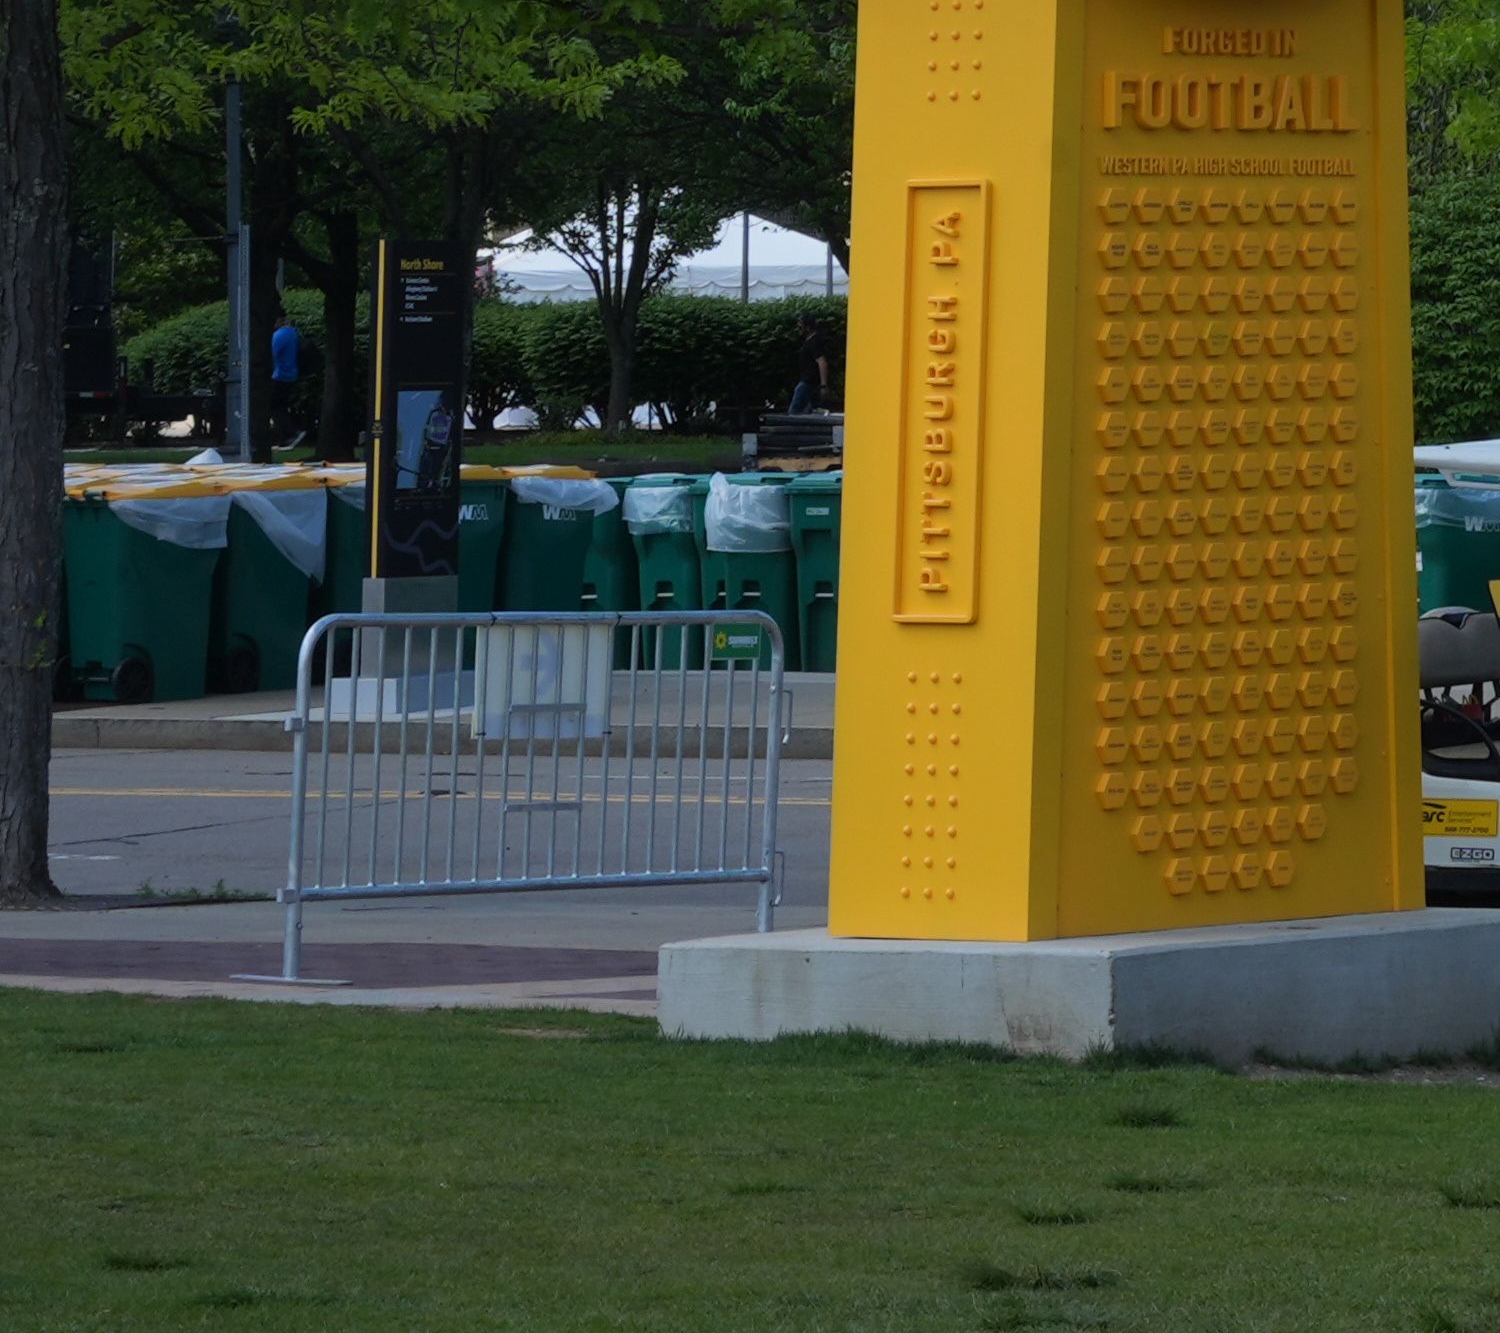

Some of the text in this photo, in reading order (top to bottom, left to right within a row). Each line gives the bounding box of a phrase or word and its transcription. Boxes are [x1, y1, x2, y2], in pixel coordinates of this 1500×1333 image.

[1161, 26, 1297, 57] FORGED IN
[1103, 71, 1359, 134] FOOTBALL
[1100, 156, 1357, 176] WESTERN PA HIGH SCHOOL FOOTBALL
[423, 259, 444, 270] Shore
[919, 211, 961, 594] PITTSBURGH PA
[1422, 811, 1446, 823] erc
